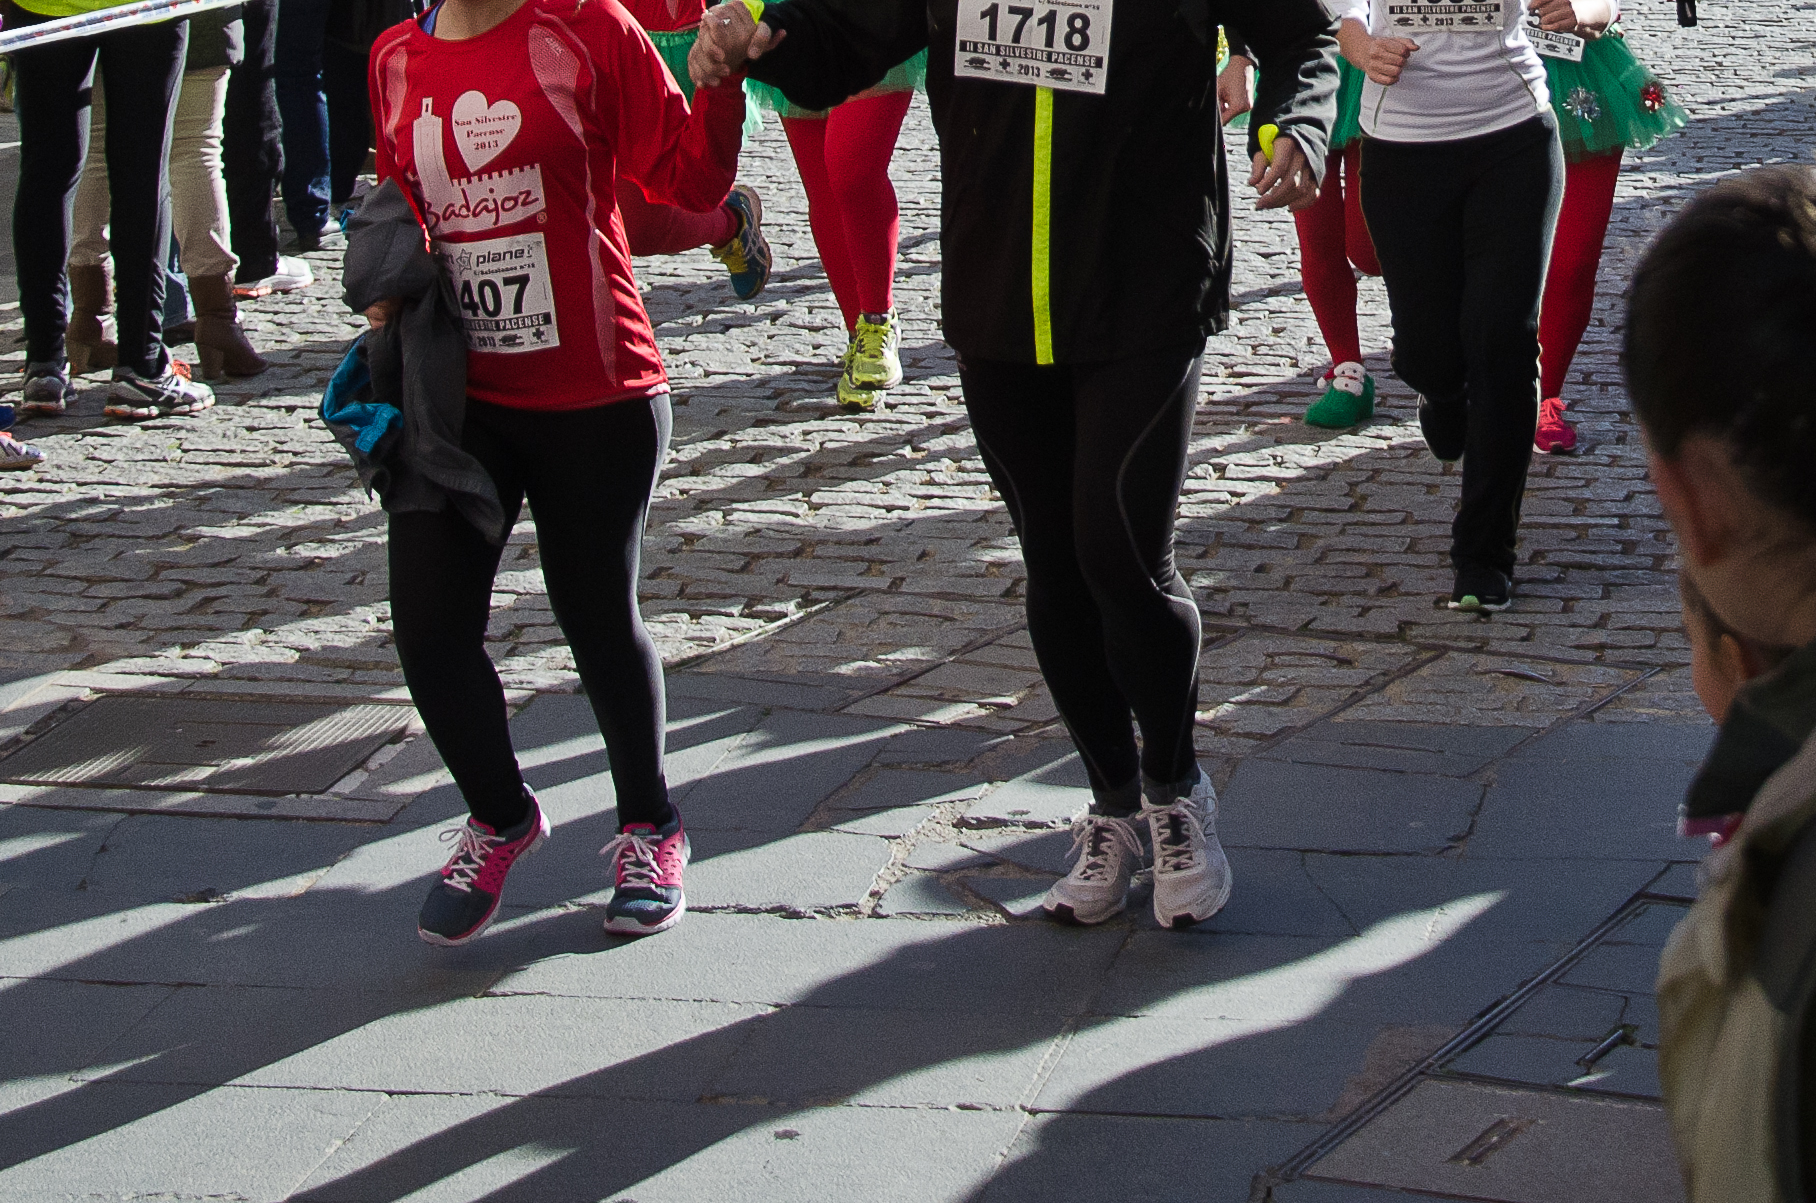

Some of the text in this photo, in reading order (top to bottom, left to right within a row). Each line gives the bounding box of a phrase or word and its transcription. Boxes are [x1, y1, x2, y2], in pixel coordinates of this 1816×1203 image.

[980, 1, 1091, 52] 1718
[1434, 17, 1454, 26] 2013
[976, 43, 996, 55] SAN
[1000, 46, 1048, 62] SILVESTRE
[1051, 51, 1097, 67] PACENSE
[1017, 63, 1041, 77] 2013
[474, 114, 517, 125] Silvestre
[466, 129, 505, 138] Pacense
[473, 140, 499, 150] 2013
[460, 273, 531, 318] 407
[499, 314, 545, 330] PACENSE
